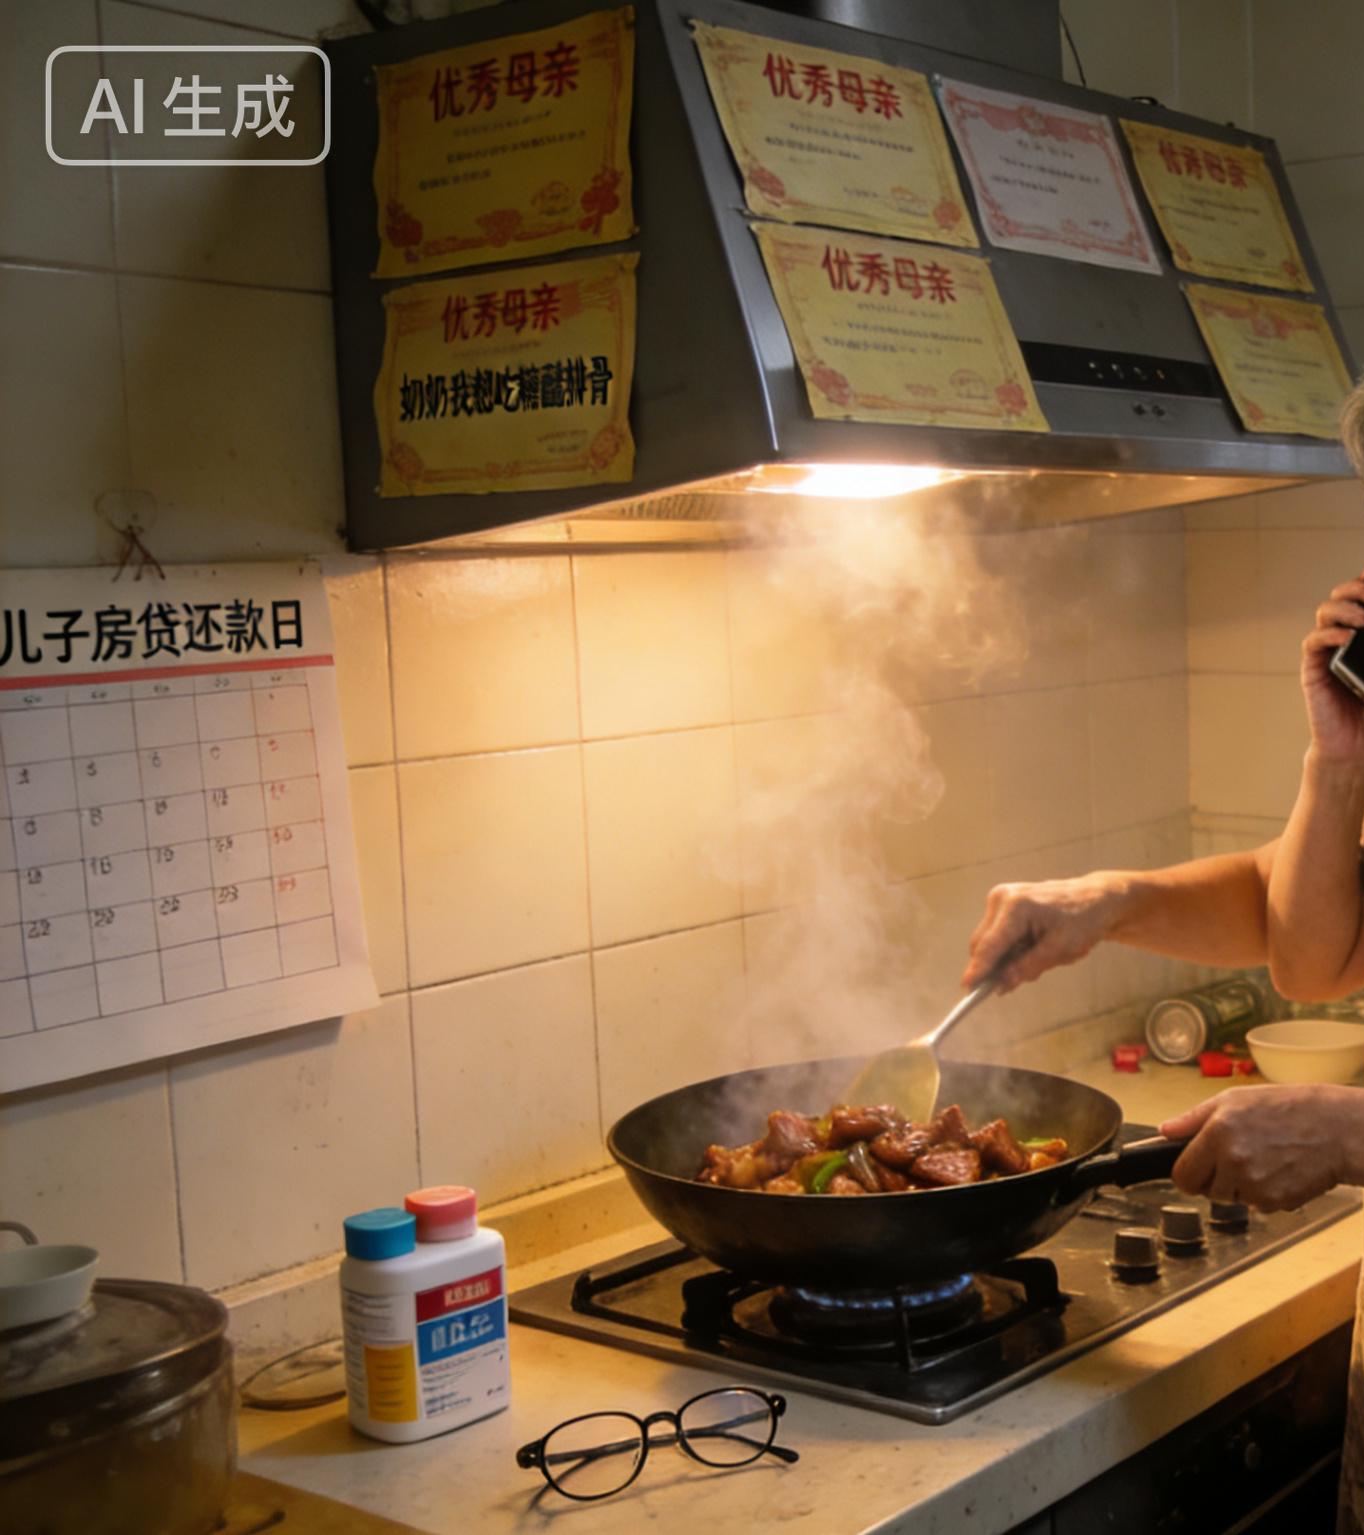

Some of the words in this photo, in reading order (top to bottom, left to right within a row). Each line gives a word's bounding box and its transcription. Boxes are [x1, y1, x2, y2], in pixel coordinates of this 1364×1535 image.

[429, 41, 580, 122] 优秀母亲
[763, 52, 904, 120] 优秀母亲
[821, 245, 957, 304] 优秀母亲
[440, 281, 563, 345] 优秀母亲
[0, 599, 304, 666] 儿子房贷还款日
